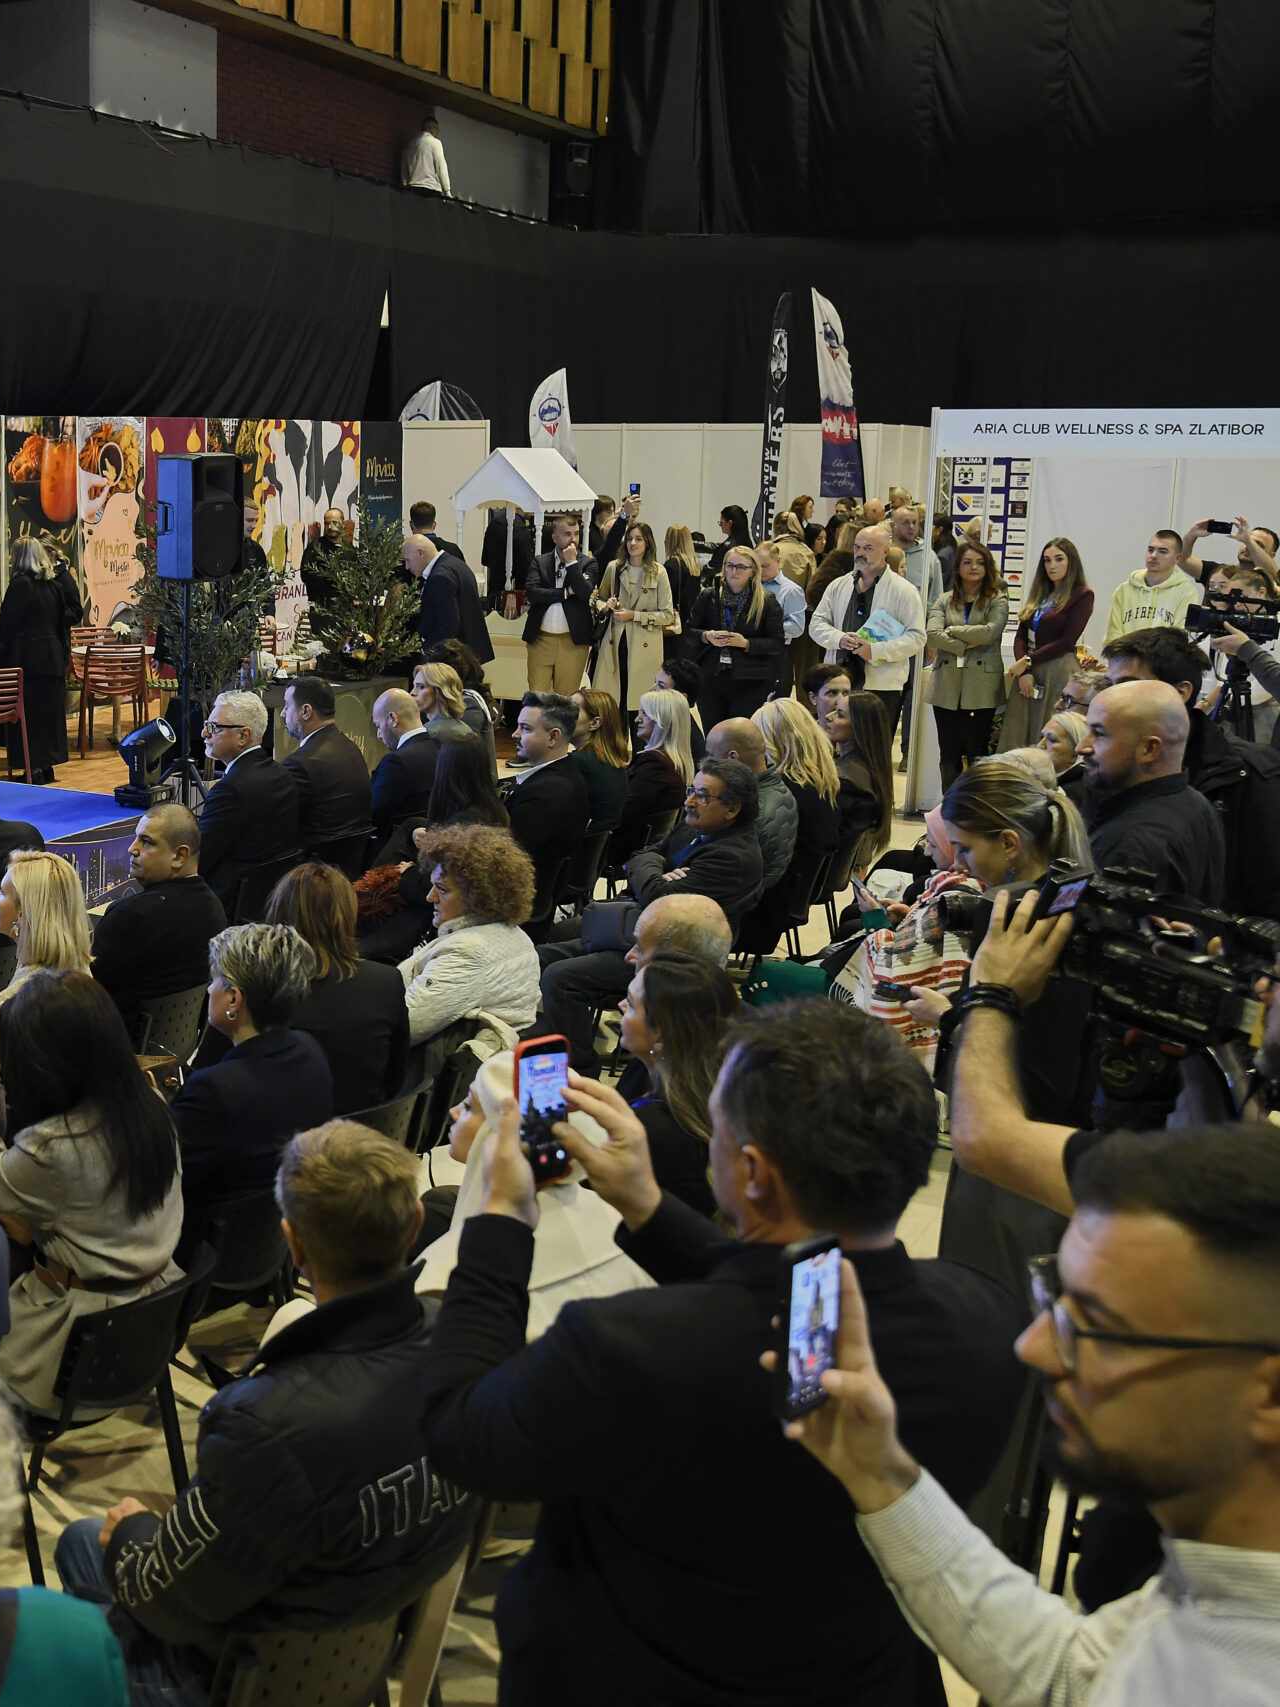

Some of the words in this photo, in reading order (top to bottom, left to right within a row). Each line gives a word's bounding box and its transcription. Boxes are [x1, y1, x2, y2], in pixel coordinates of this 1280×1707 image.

[973, 423, 1008, 434] ARIA
[1012, 423, 1050, 434] CLUB
[1055, 423, 1134, 435] WELLNESS
[1138, 423, 1150, 435] &
[1155, 423, 1183, 435] SPA
[1189, 423, 1265, 435] ZLATIBOR
[358, 1456, 470, 1548] ITA
